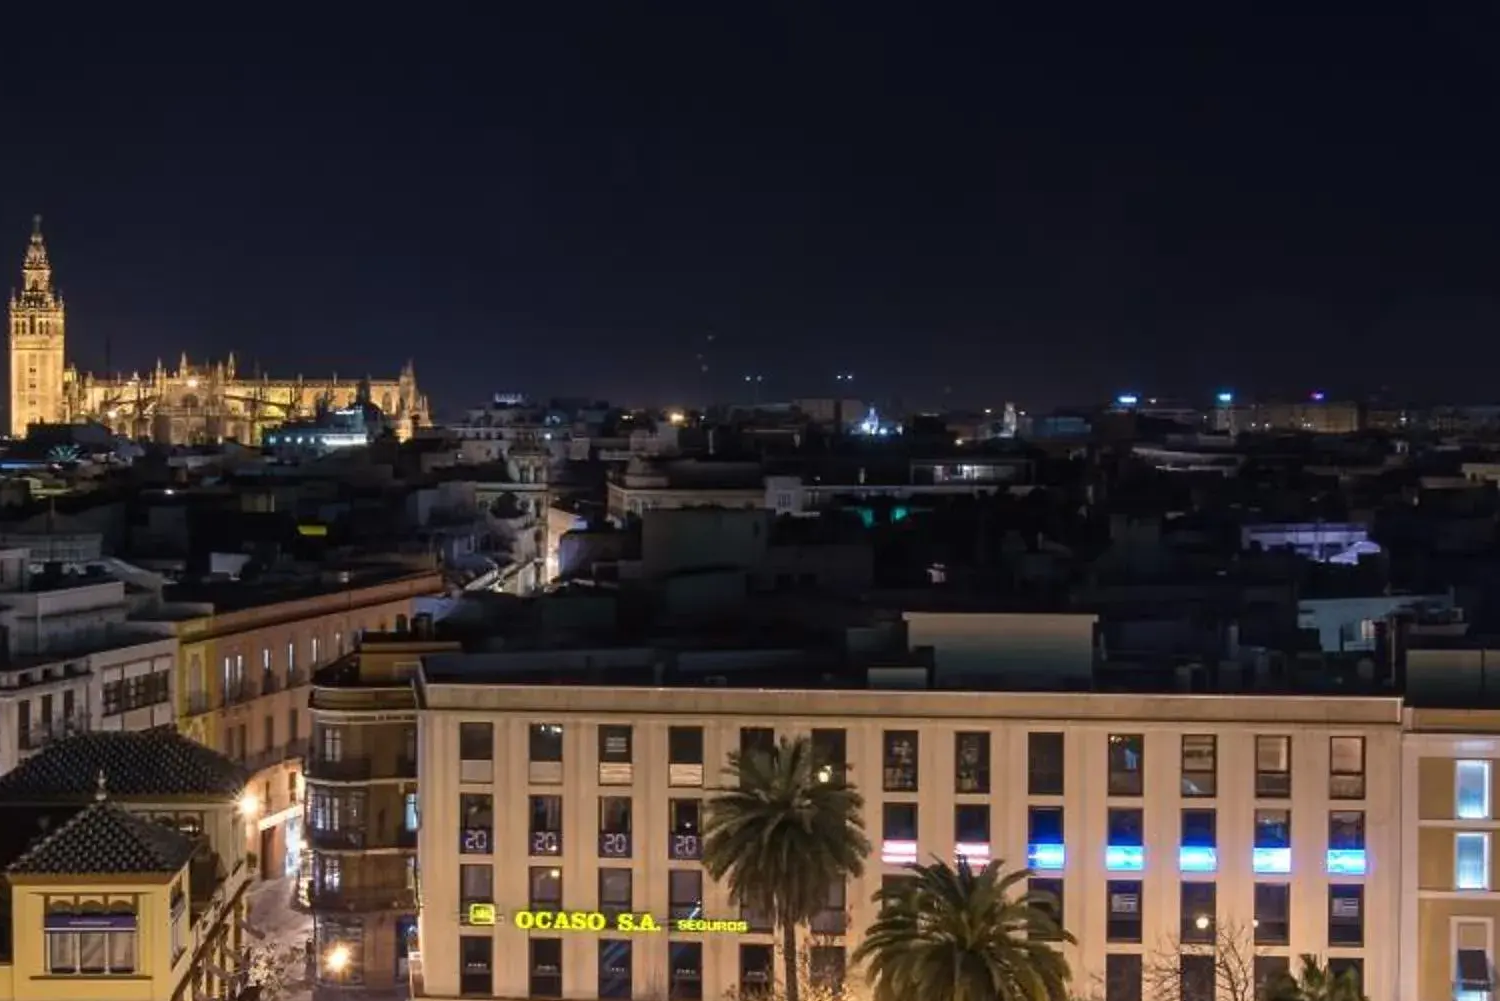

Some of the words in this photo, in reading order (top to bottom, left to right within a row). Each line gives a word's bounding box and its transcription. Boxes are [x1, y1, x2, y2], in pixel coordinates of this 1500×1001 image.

[515, 911, 606, 930] OCASO
[617, 913, 661, 931] S.A.
[677, 920, 748, 932] SEGUROS
